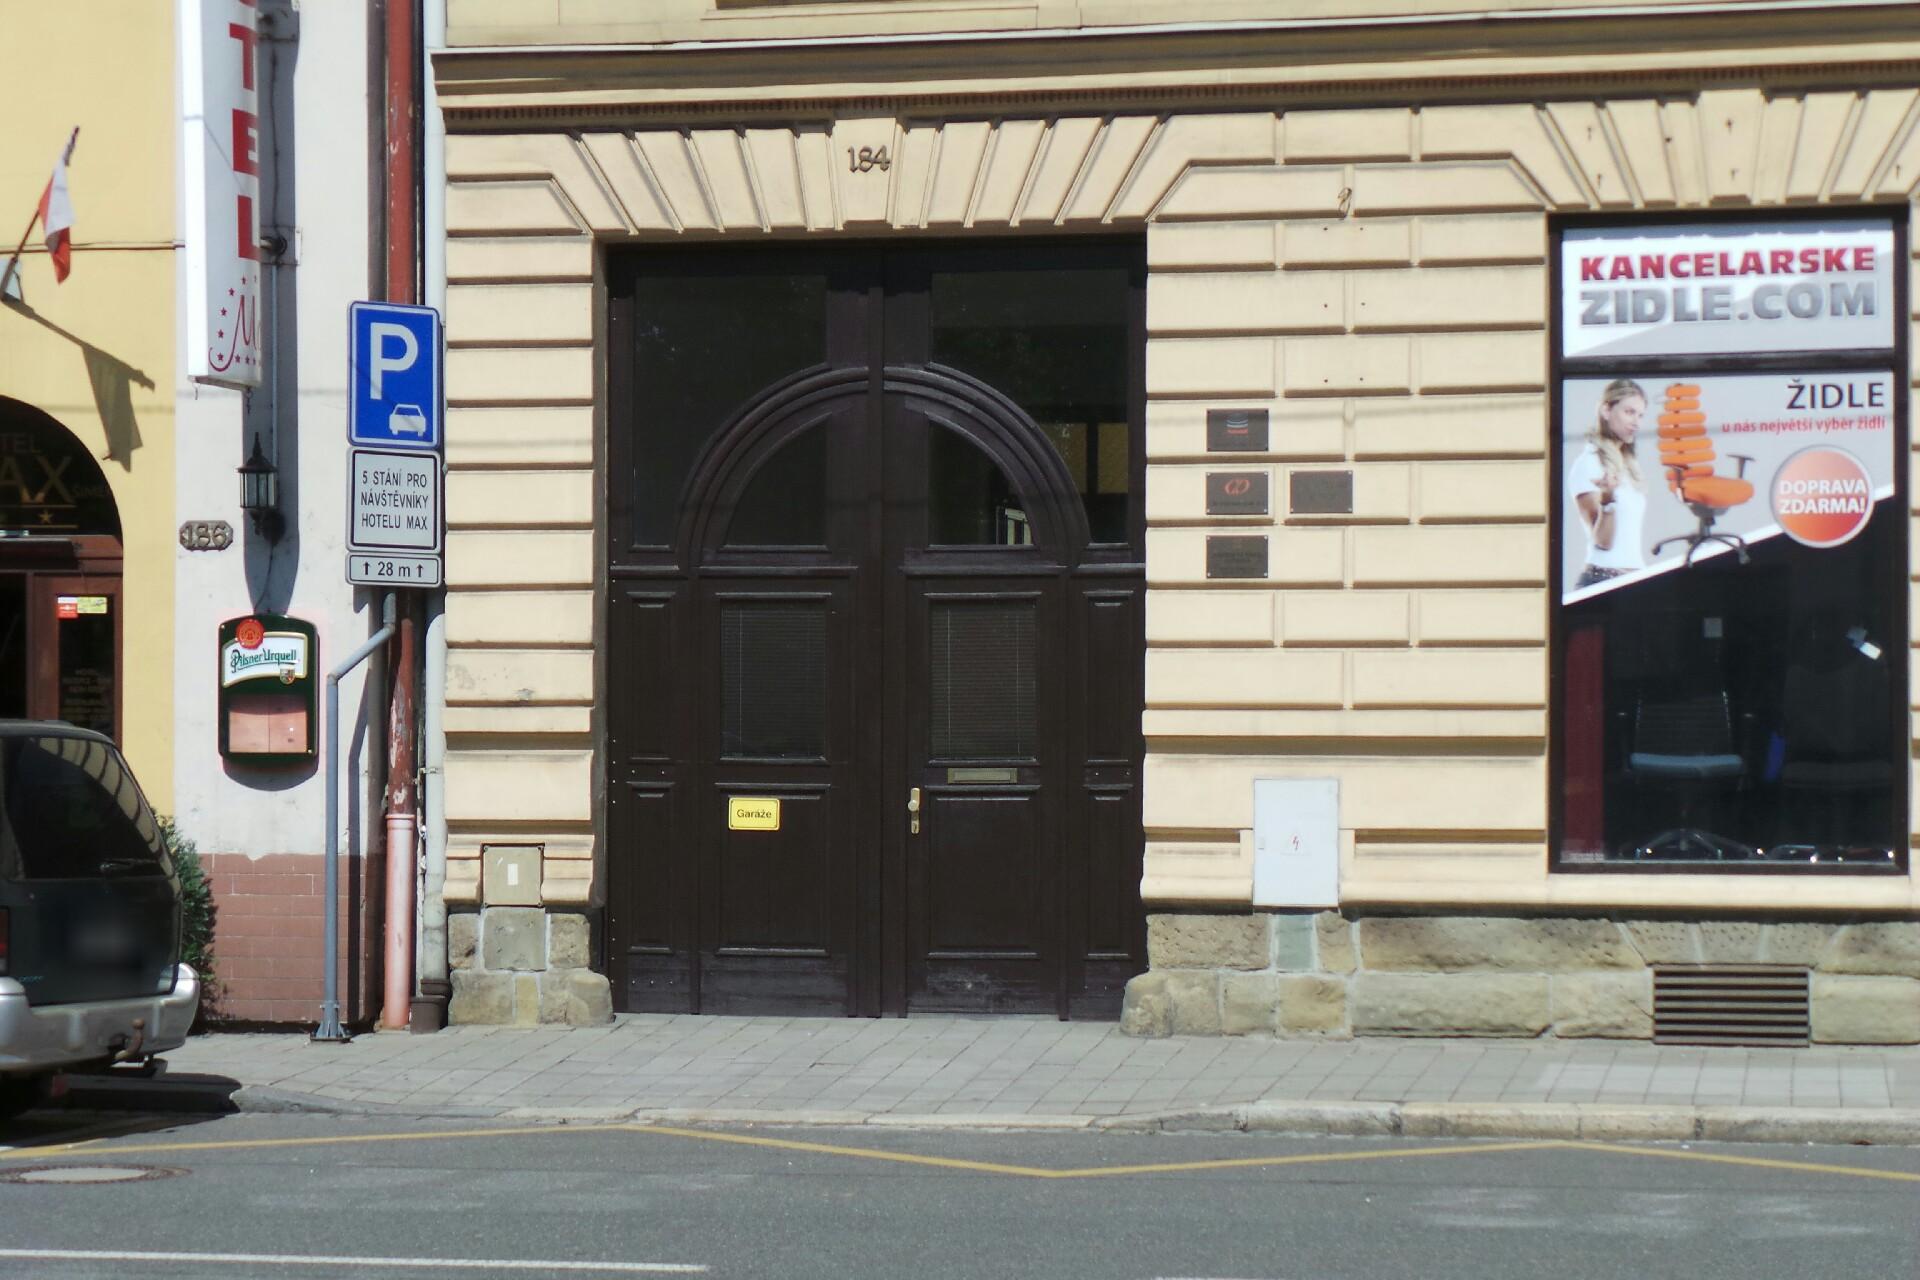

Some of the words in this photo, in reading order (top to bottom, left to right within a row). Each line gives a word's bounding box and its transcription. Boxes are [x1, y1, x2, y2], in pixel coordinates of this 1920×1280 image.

[229, 0, 260, 260] TEL
[847, 145, 891, 173] 184
[1580, 246, 1876, 281] KANCELARSKE
[1580, 282, 1876, 326] ZIDLE.COM
[370, 322, 418, 400] P
[1786, 378, 1885, 410] ŽIDLE
[1722, 423, 1731, 433] u
[1734, 418, 1757, 432] nás
[1816, 416, 1854, 434] výběr
[362, 470, 368, 485] 5
[373, 467, 402, 487] STÁNÍ
[407, 473, 427, 488] PRO
[1779, 479, 1867, 495] DOPRAVA
[361, 488, 429, 510] NÁVŠTĚVNÍKY
[1779, 498, 1866, 515] ZDARMA!
[362, 513, 401, 529] HOTELU
[407, 515, 428, 530] MAX
[378, 561, 394, 577] 28
[398, 565, 411, 578] m
[230, 649, 263, 674] Pilsner
[262, 647, 297, 666] Urquell
[736, 809, 772, 818] Garáže
